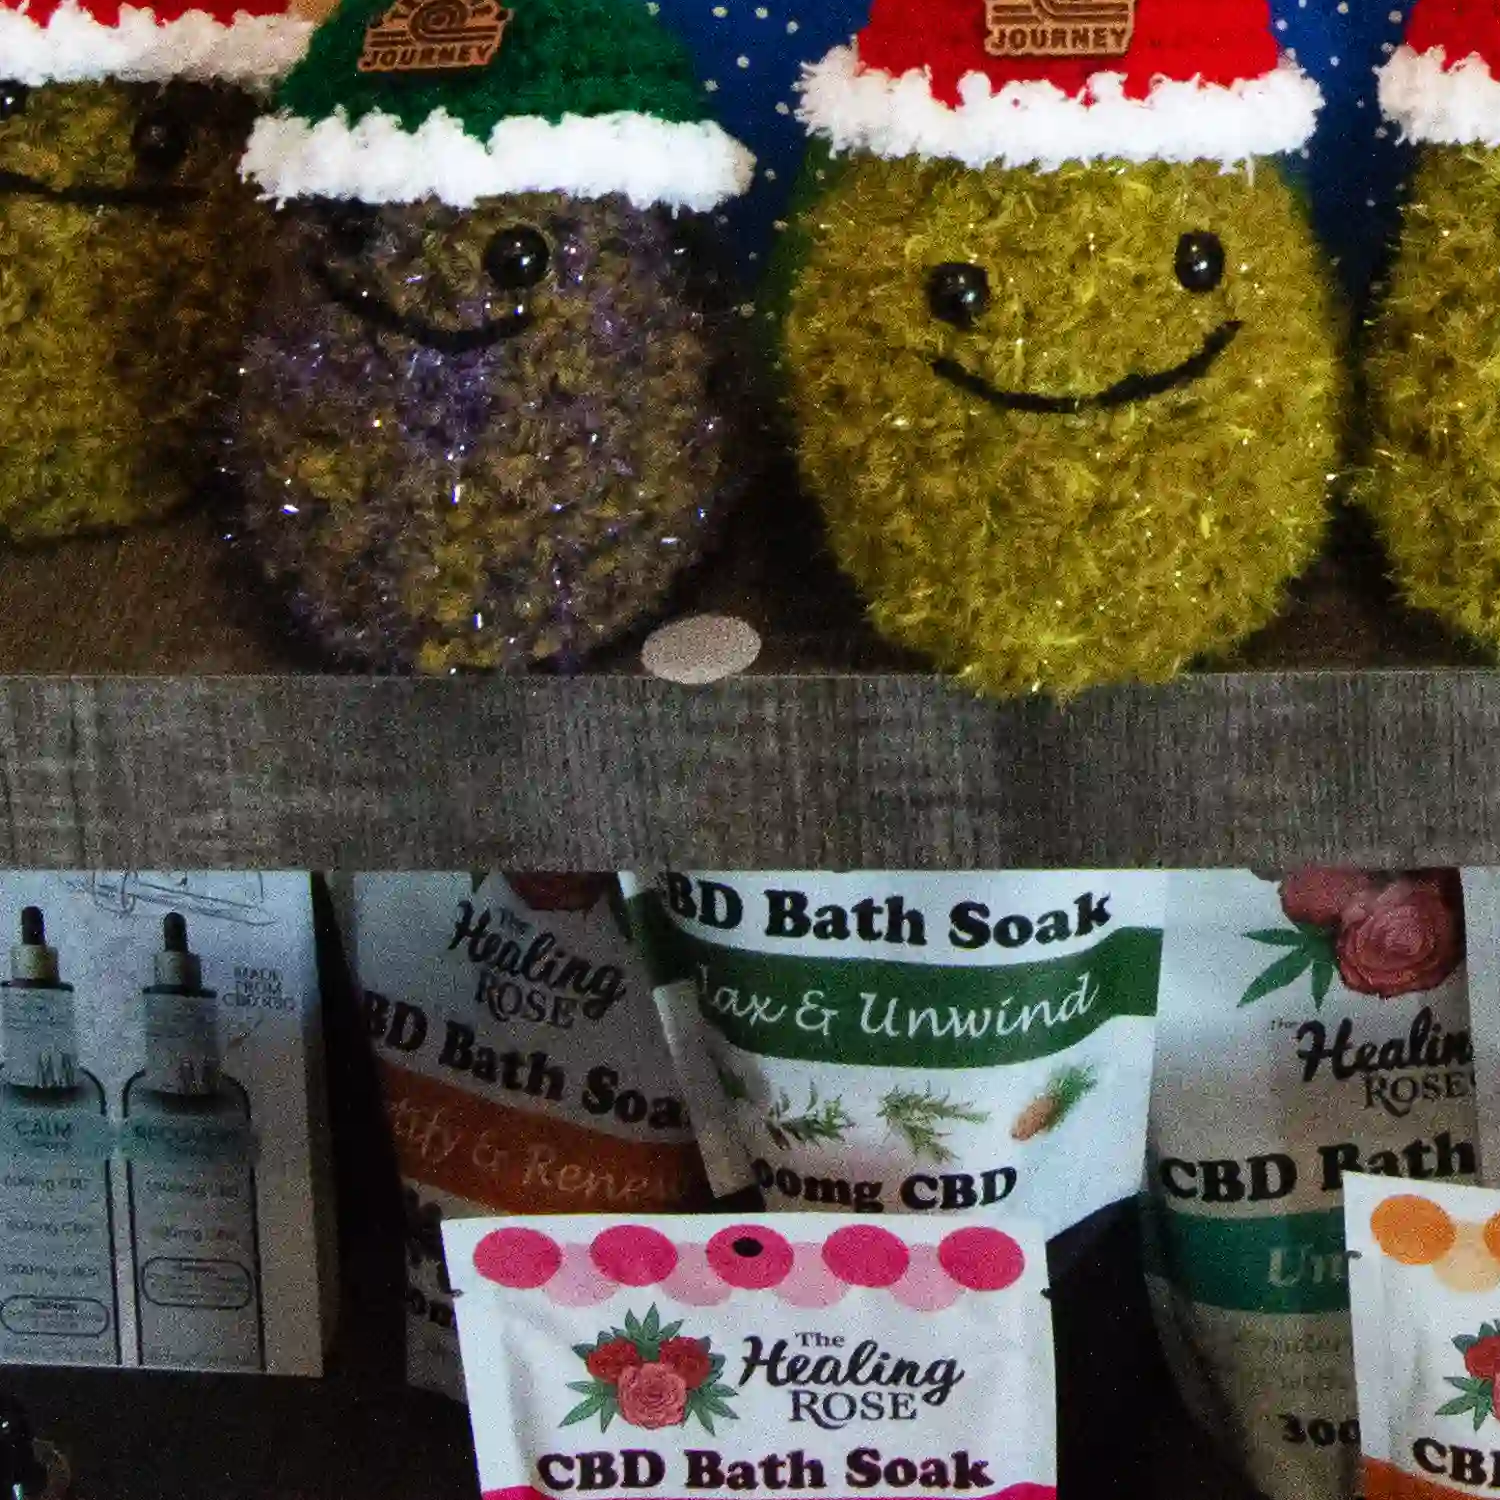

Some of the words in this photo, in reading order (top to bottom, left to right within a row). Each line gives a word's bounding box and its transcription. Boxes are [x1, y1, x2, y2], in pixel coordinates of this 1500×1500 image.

[990, 27, 1126, 50] JOURNEY
[664, 871, 743, 930] BD
[763, 888, 928, 948] Bath
[948, 890, 1112, 950] Soak
[448, 900, 627, 1020] Healing
[475, 966, 576, 1029] ROSE
[794, 990, 839, 1036] &
[858, 970, 1101, 1040] Unwind
[362, 989, 428, 1052] BD
[438, 1018, 568, 1102] Bath
[581, 1063, 692, 1131] Soa
[1295, 1005, 1476, 1082] Healin
[1361, 1071, 1468, 1118] ROSE
[752, 1157, 885, 1214] 00mg
[901, 1166, 1018, 1210] CBD
[1159, 1153, 1298, 1202] CBD
[795, 1331, 845, 1348] The
[738, 1335, 966, 1407] Healing
[787, 1389, 918, 1431] ROSE
[1276, 1411, 1361, 1448] 300
[537, 1448, 666, 1491] CBD
[684, 1447, 827, 1491] Bath
[845, 1446, 996, 1491] Soak
